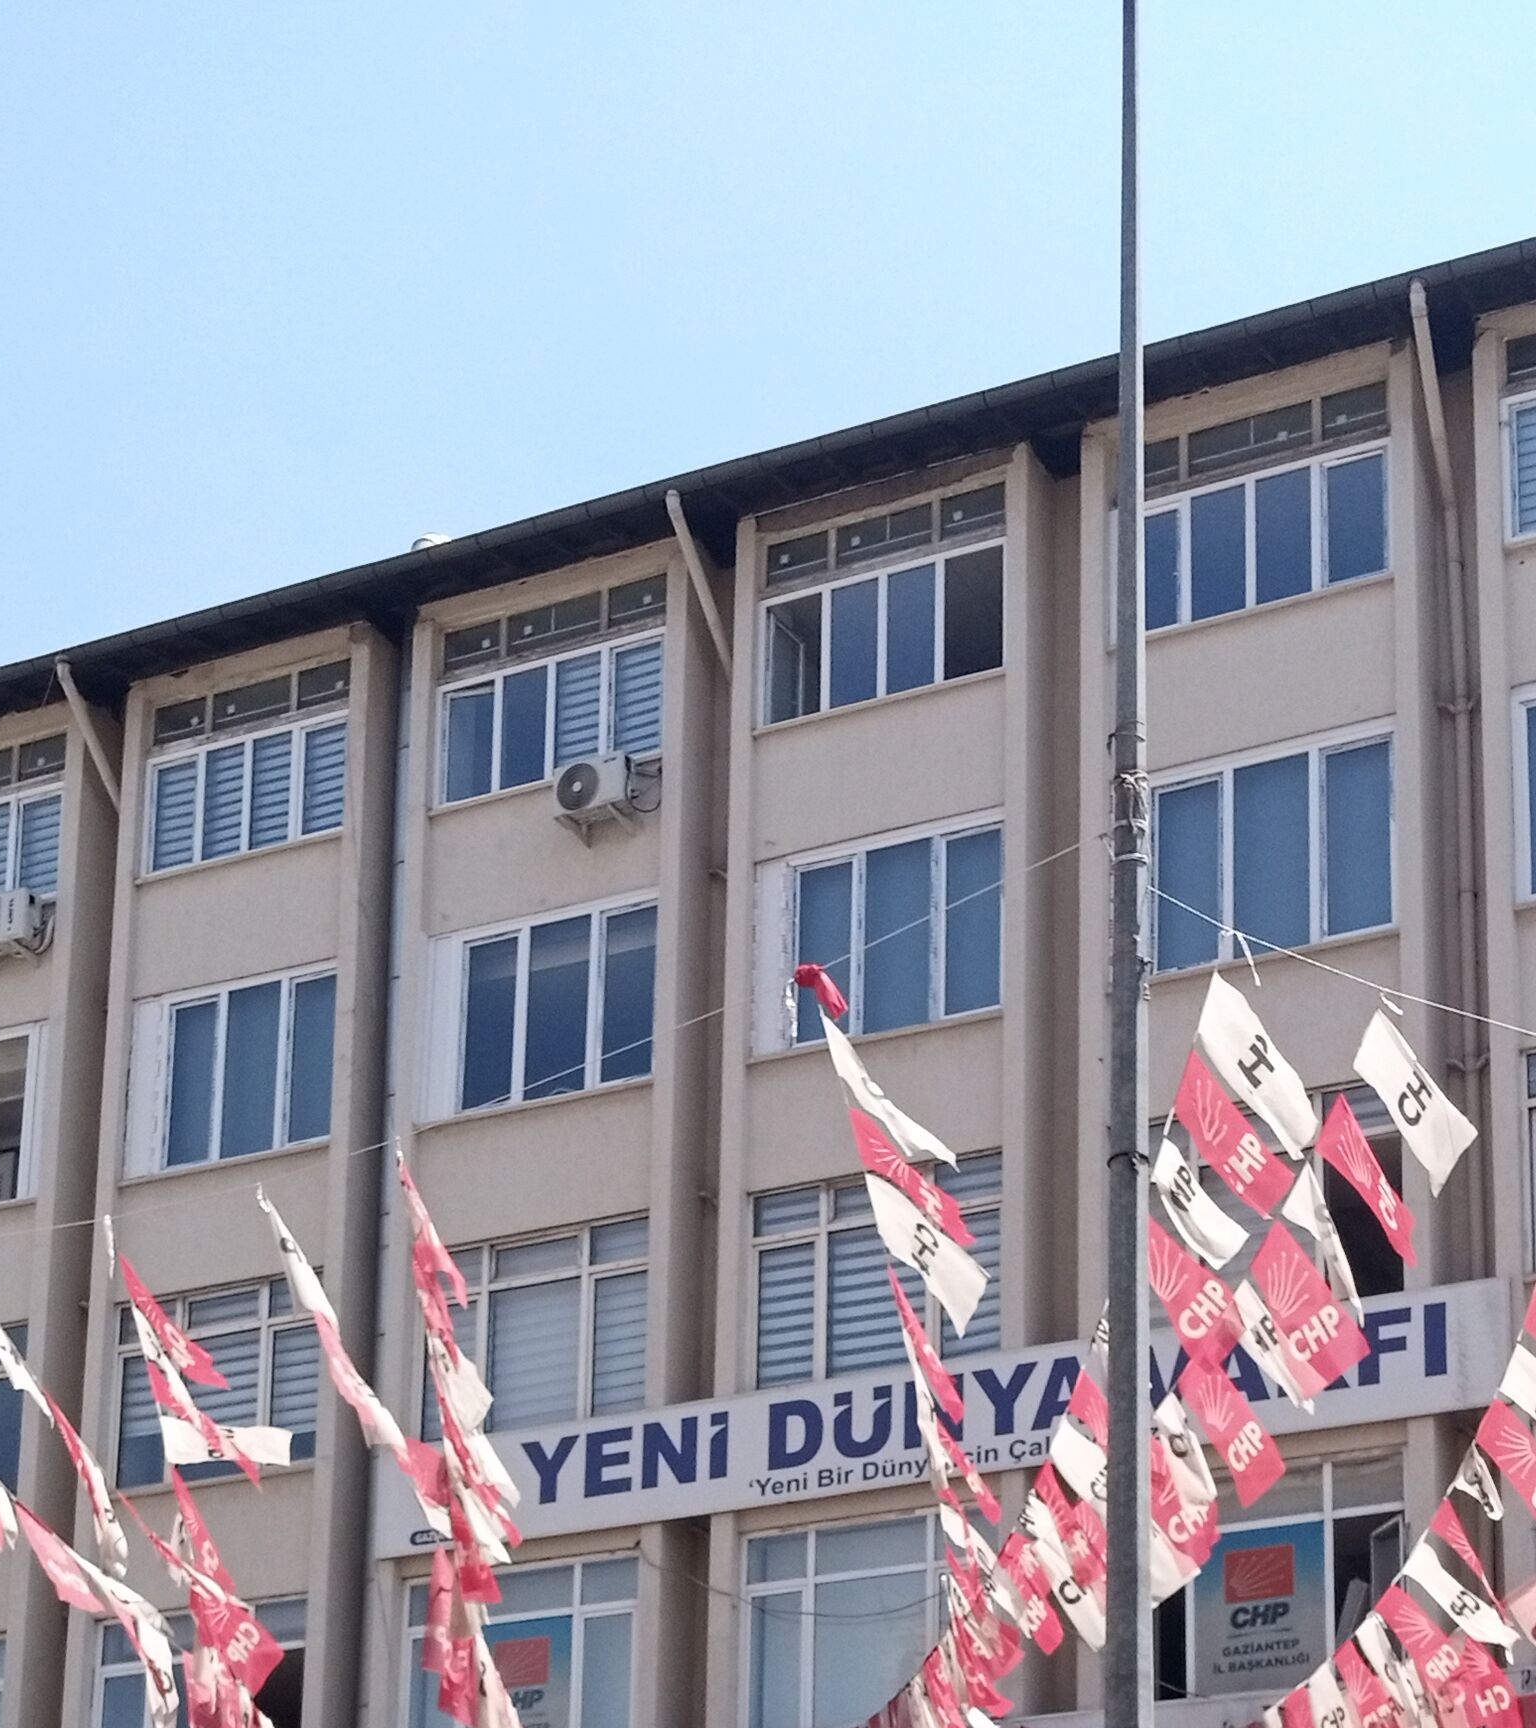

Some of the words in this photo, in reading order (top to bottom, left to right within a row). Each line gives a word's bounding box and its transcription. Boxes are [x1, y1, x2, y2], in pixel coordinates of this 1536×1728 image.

[1398, 1066, 1433, 1128] CH
[1178, 1278, 1228, 1340] CHP
[1289, 1303, 1343, 1362] CHP
[1227, 1420, 1266, 1474] CHP
[818, 1465, 854, 1488] Bir
[864, 1455, 929, 1482] Düny
[1230, 1601, 1290, 1630] CHP
[1222, 1637, 1301, 1660] GAZİANTEP
[1229, 1650, 1311, 1675] BAŞKANLIĞI
[514, 1689, 546, 1710] HP
